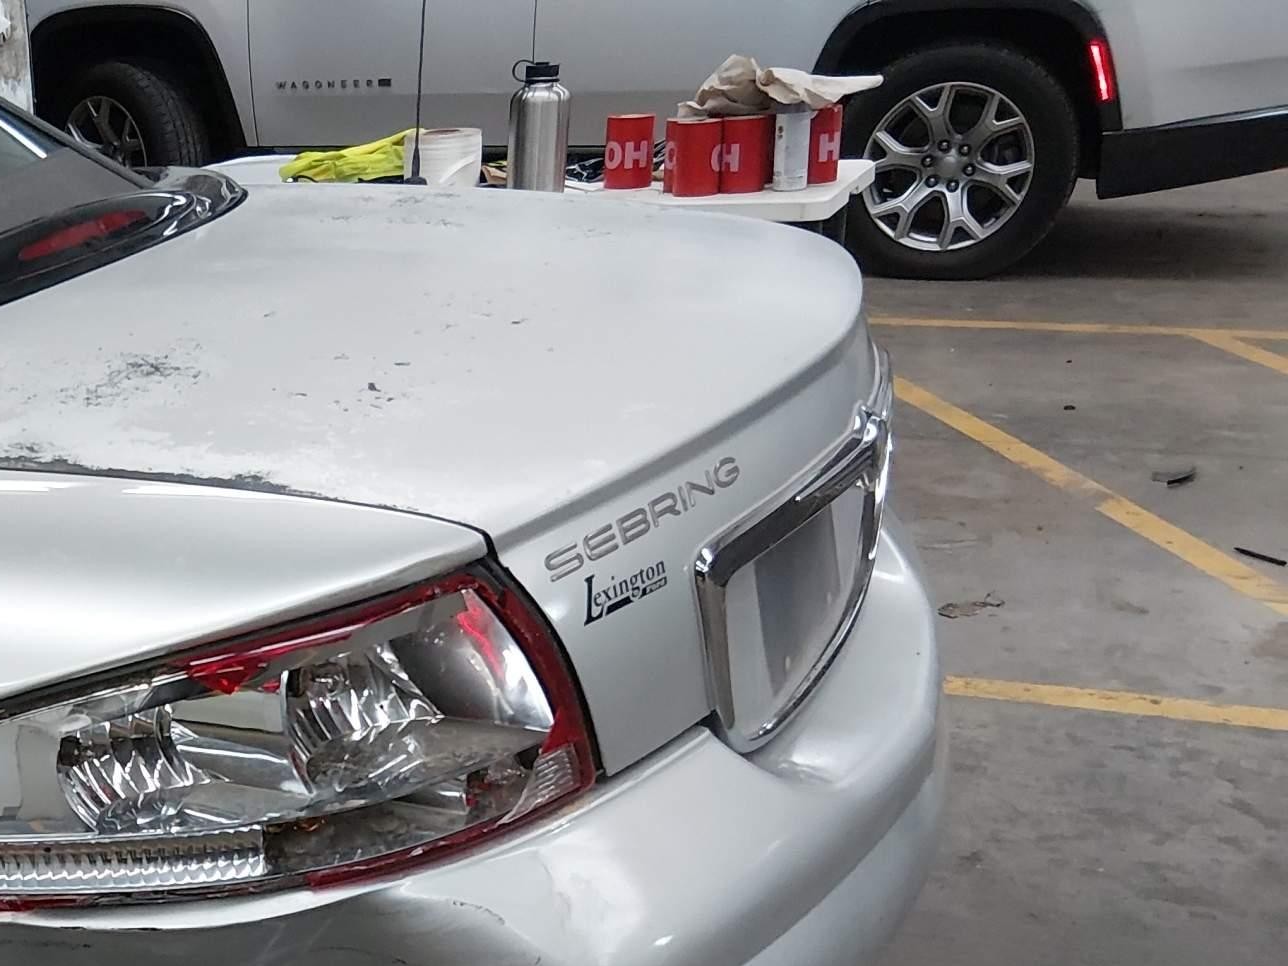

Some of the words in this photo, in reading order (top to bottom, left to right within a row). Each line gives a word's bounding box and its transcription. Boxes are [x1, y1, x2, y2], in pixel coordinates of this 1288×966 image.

[276, 79, 373, 90] WAGONEER
[544, 456, 740, 583] SEBRING
[584, 560, 666, 627] Lexington
